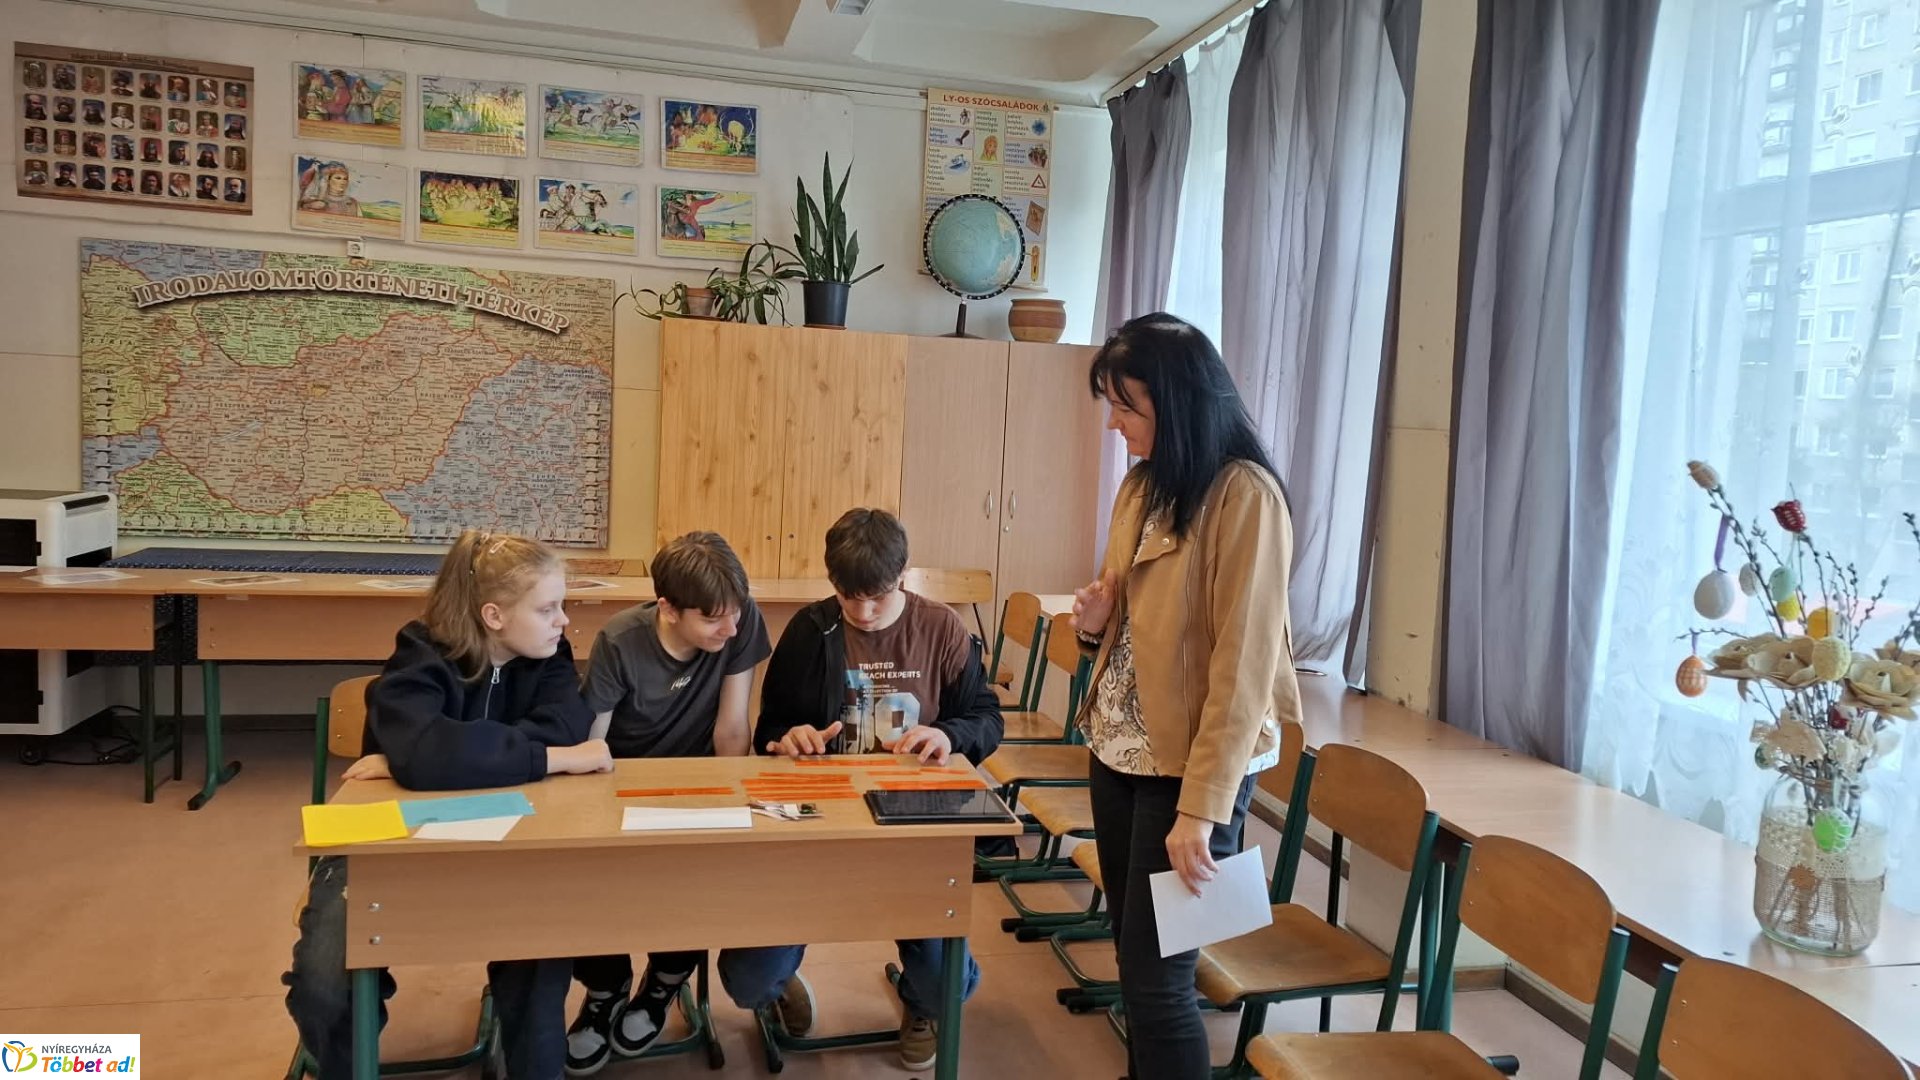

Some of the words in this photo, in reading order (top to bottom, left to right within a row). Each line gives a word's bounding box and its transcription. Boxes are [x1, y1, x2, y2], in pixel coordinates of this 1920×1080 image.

[943, 94, 970, 104] LY-OS
[972, 97, 1040, 111] SZÓCSALÁDOK
[133, 266, 458, 307] IRODALOMTÖRTÉNETI
[465, 285, 570, 334] TÉRKÉP
[859, 662, 894, 670] TRUSTED
[887, 671, 921, 679] EXPERTS
